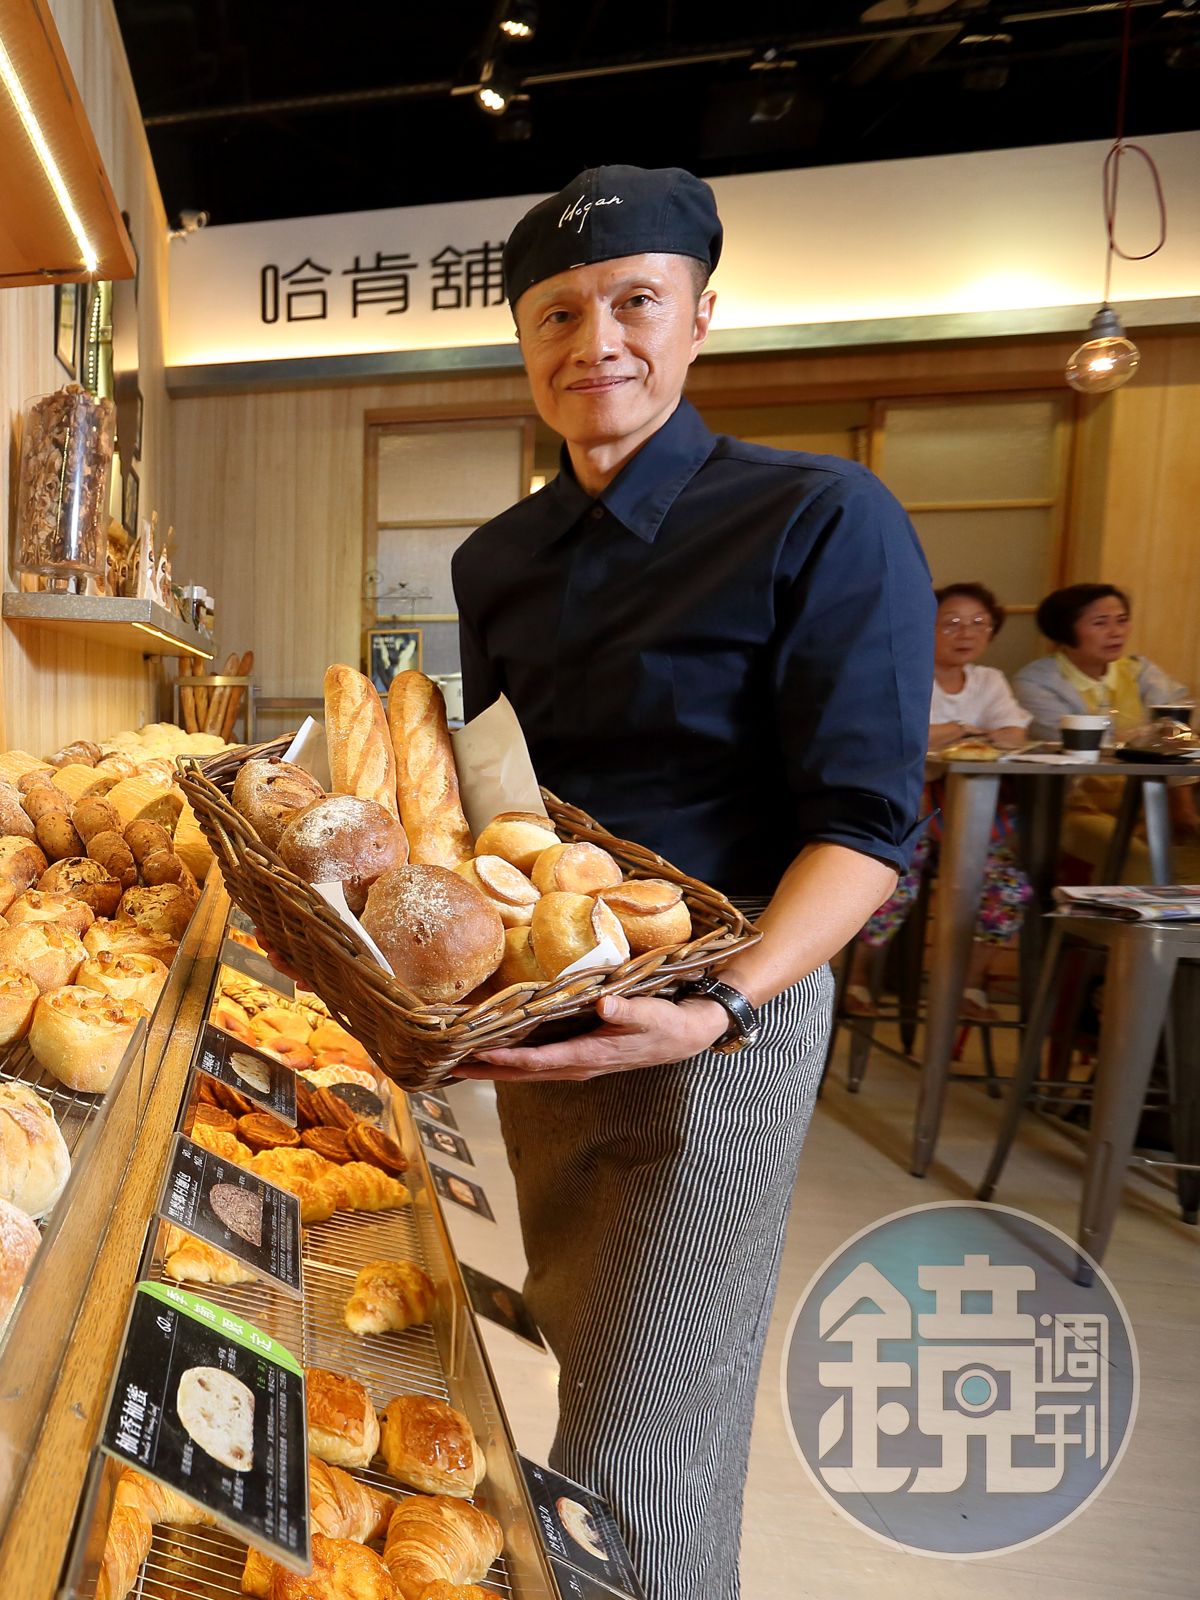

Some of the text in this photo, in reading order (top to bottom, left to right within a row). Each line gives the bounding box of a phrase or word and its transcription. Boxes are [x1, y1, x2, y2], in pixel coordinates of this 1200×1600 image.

[558, 194, 624, 233] Hogan
[260, 239, 506, 325] 哈肯舖
[155, 1315, 171, 1333] 60
[115, 1383, 149, 1454] 柚香柚蜜
